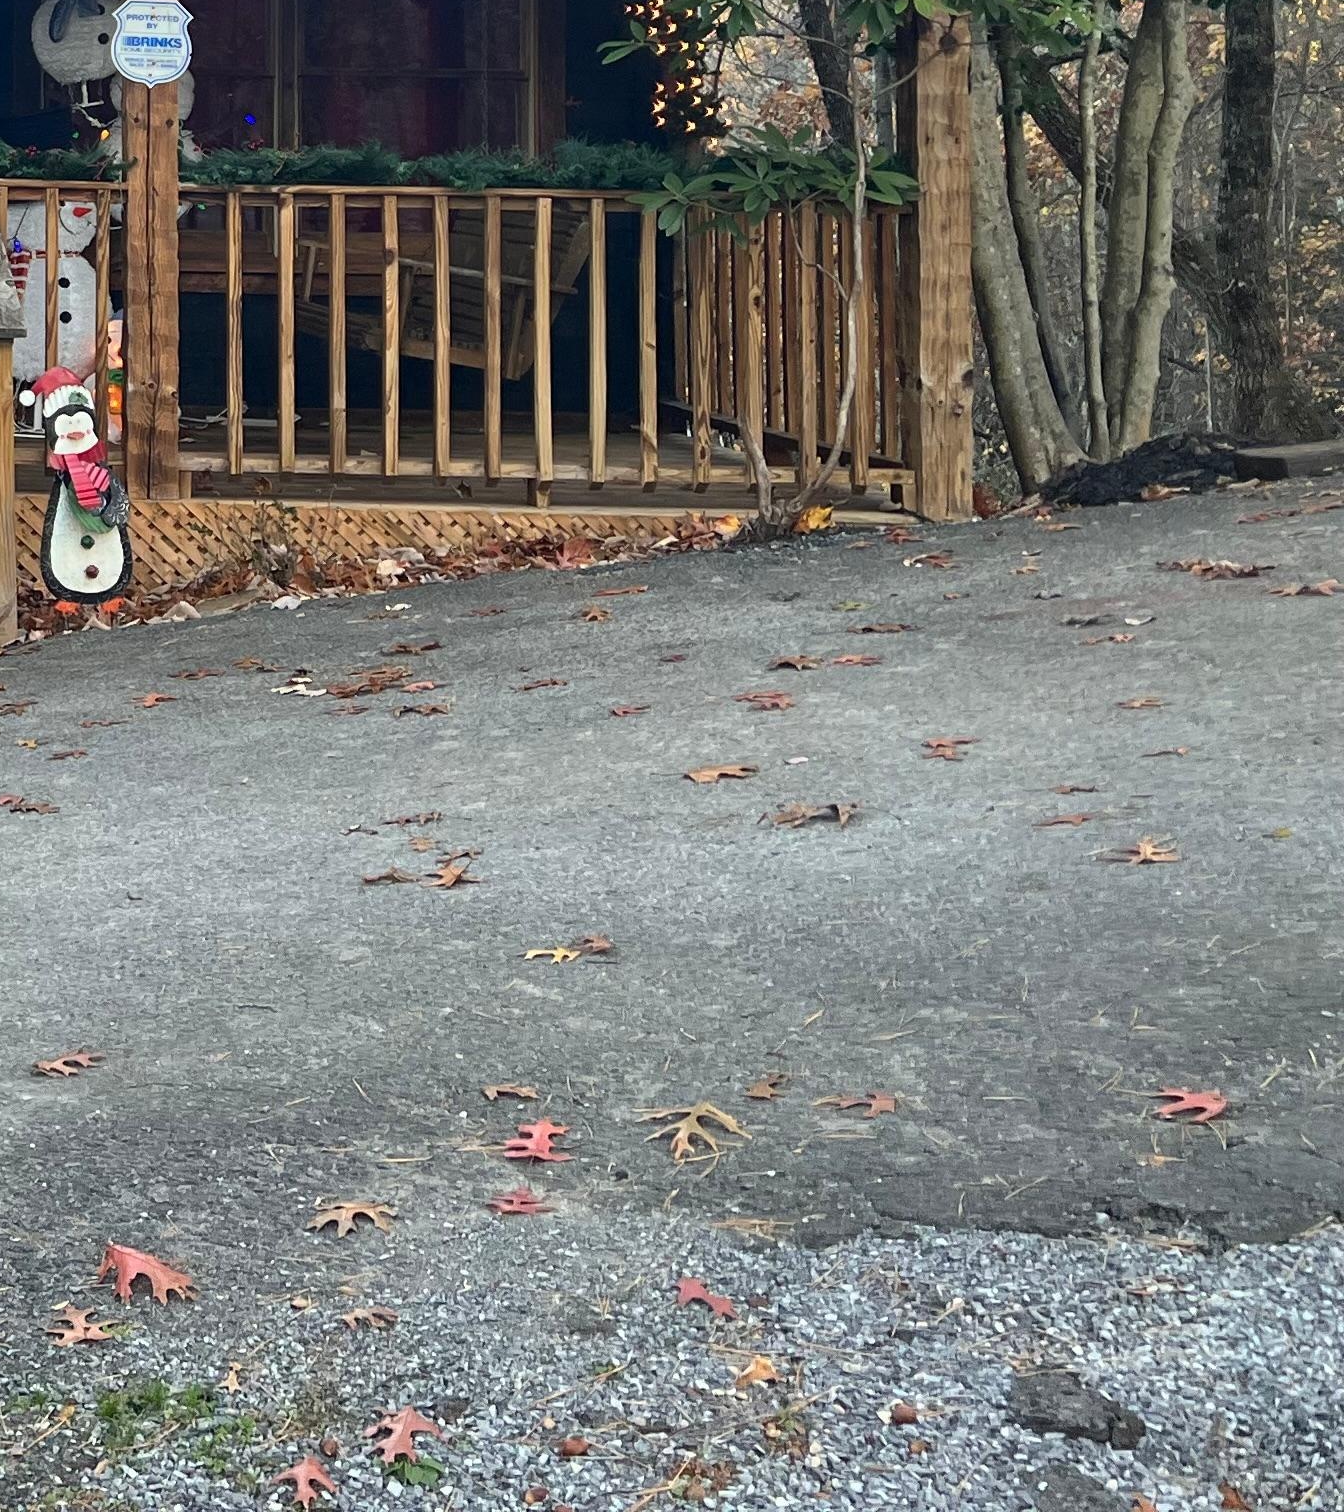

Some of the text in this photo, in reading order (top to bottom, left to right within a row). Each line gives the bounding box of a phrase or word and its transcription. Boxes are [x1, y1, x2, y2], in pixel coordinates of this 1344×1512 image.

[126, 14, 179, 23] PROTECTED
[146, 22, 158, 30] BY
[131, 36, 183, 49] BRINKS
